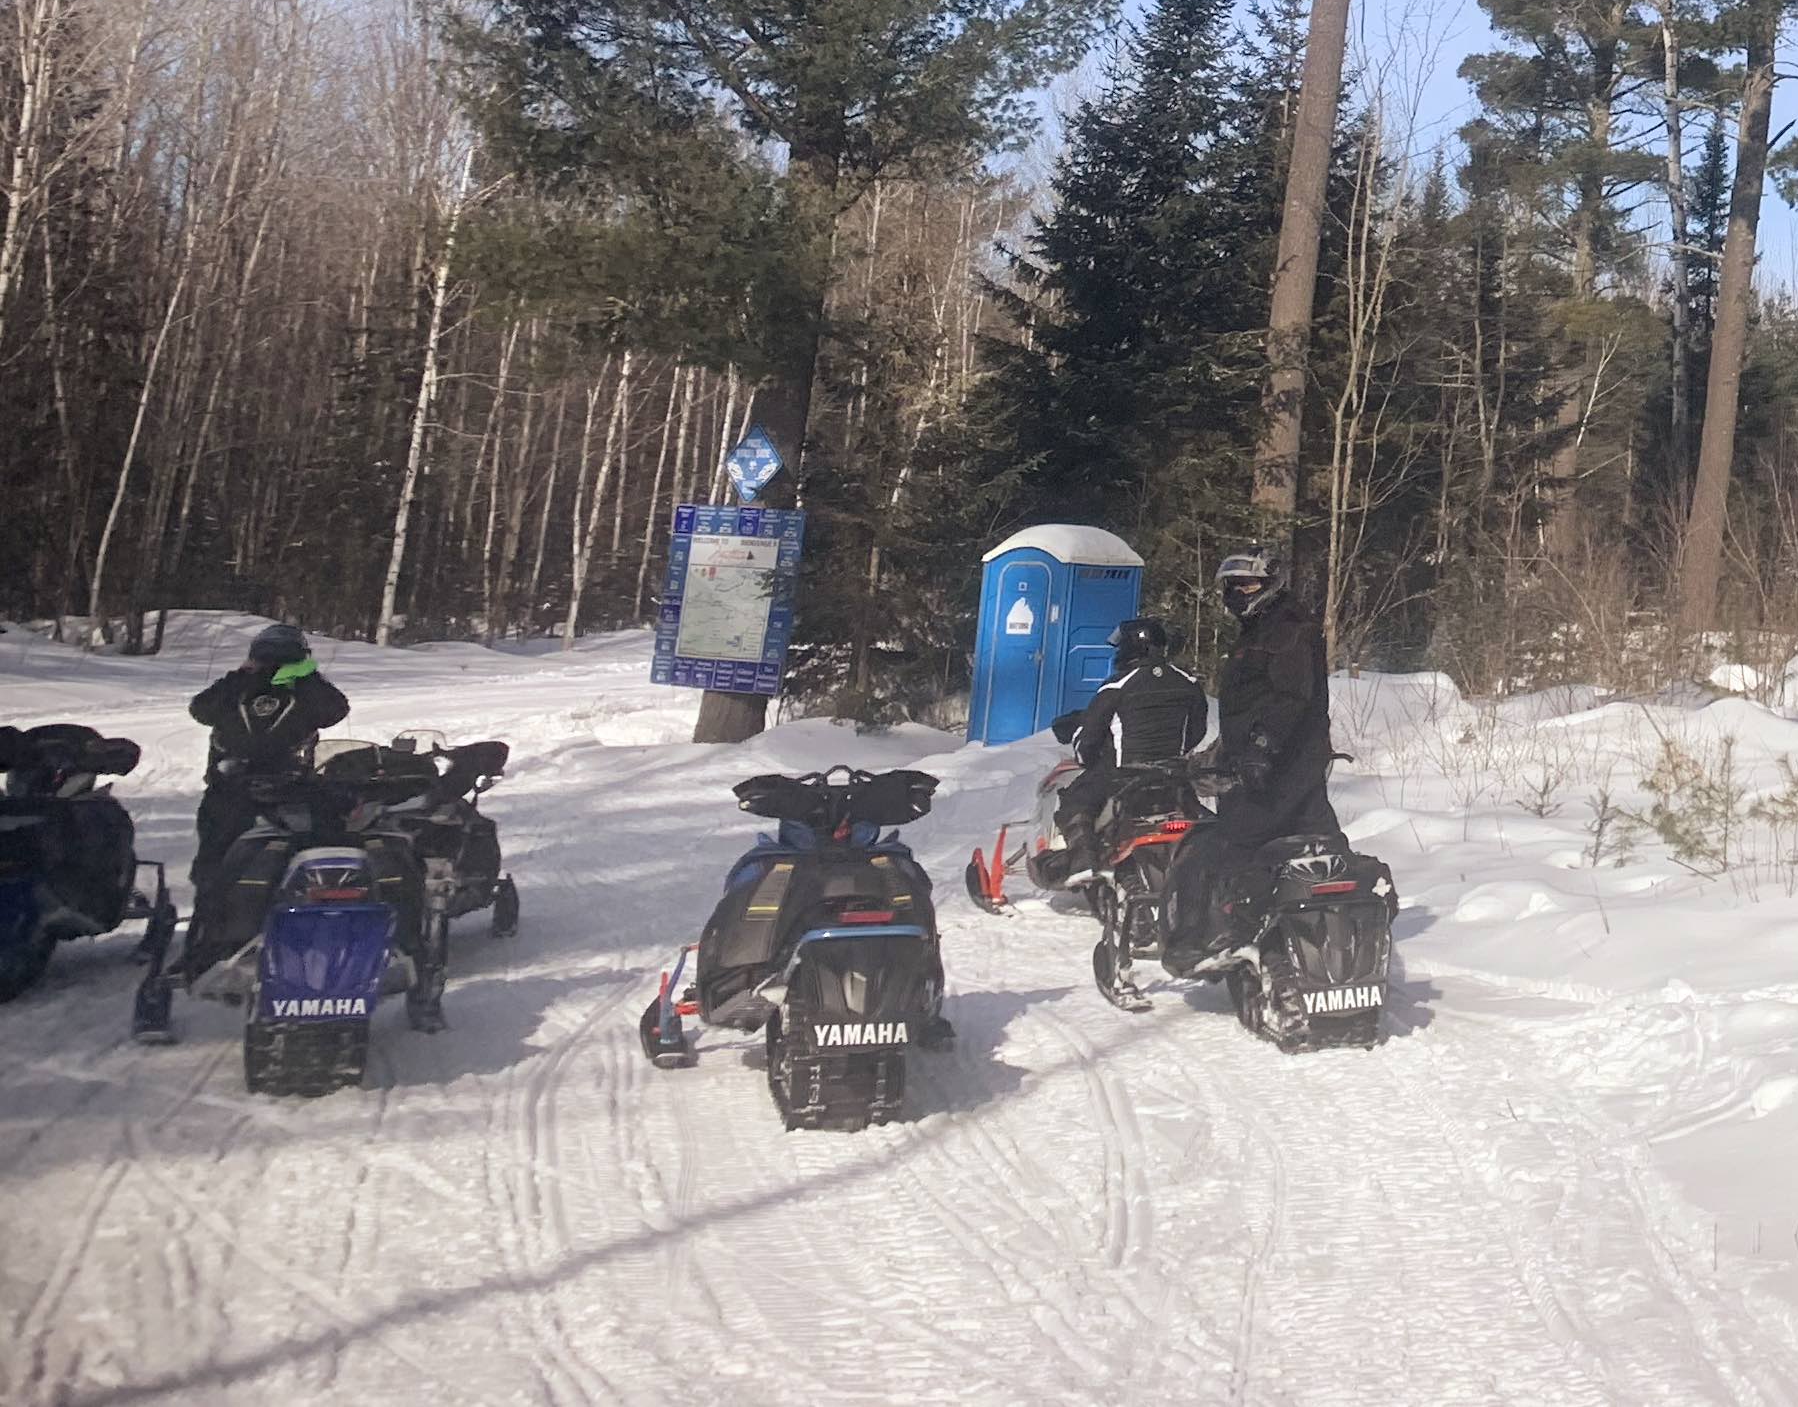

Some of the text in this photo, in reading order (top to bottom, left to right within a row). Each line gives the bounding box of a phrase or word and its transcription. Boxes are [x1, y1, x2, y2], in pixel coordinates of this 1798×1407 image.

[272, 998, 366, 1016] YAMAHA
[1303, 986, 1383, 1014] YAMAHA
[814, 1022, 909, 1047] YAMAHA
